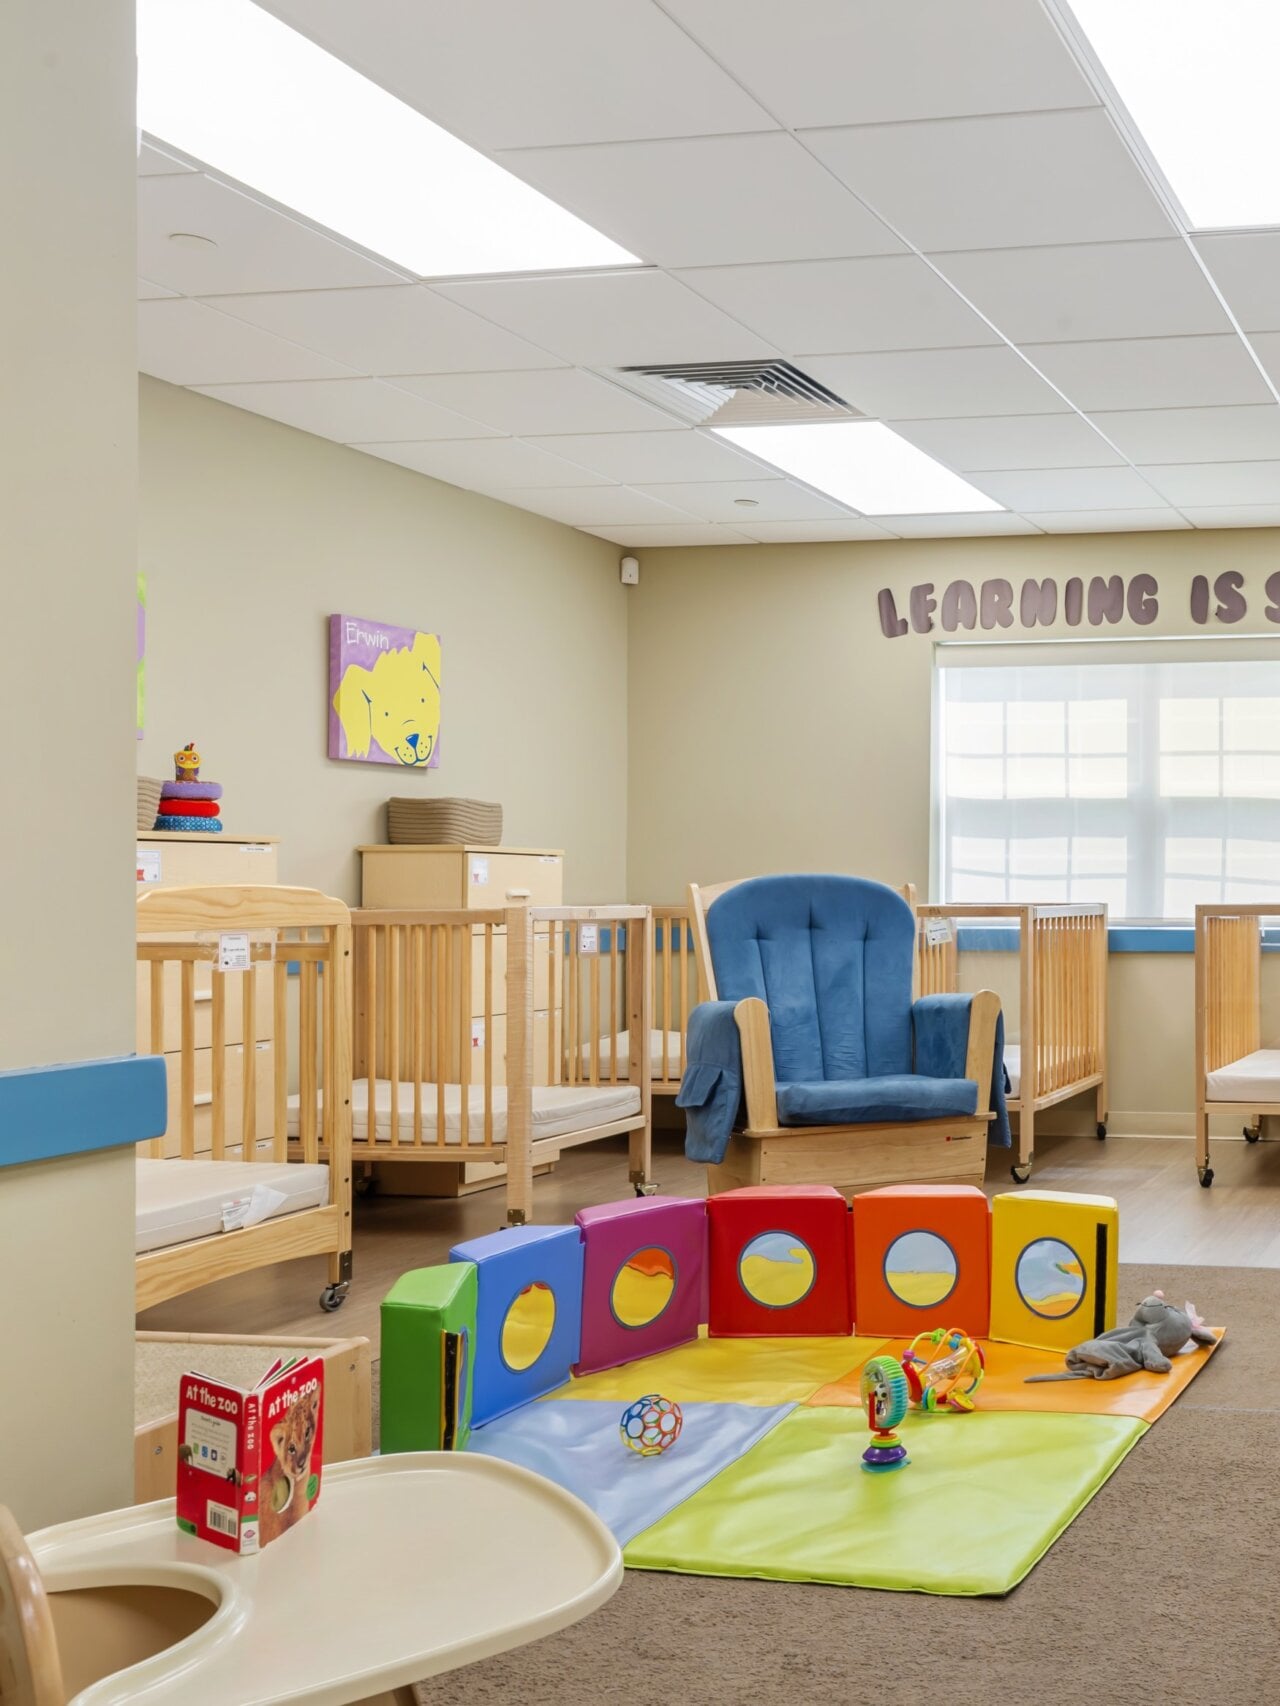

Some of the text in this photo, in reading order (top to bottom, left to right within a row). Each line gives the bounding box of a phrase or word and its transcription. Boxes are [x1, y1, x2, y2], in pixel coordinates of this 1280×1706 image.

[877, 573, 1159, 638] LEARNING
[1190, 570, 1247, 625] IS
[346, 622, 389, 650] Erwin
[186, 1384, 198, 1401] At
[199, 1387, 216, 1408] the
[268, 1396, 281, 1418] At
[282, 1389, 298, 1408] the
